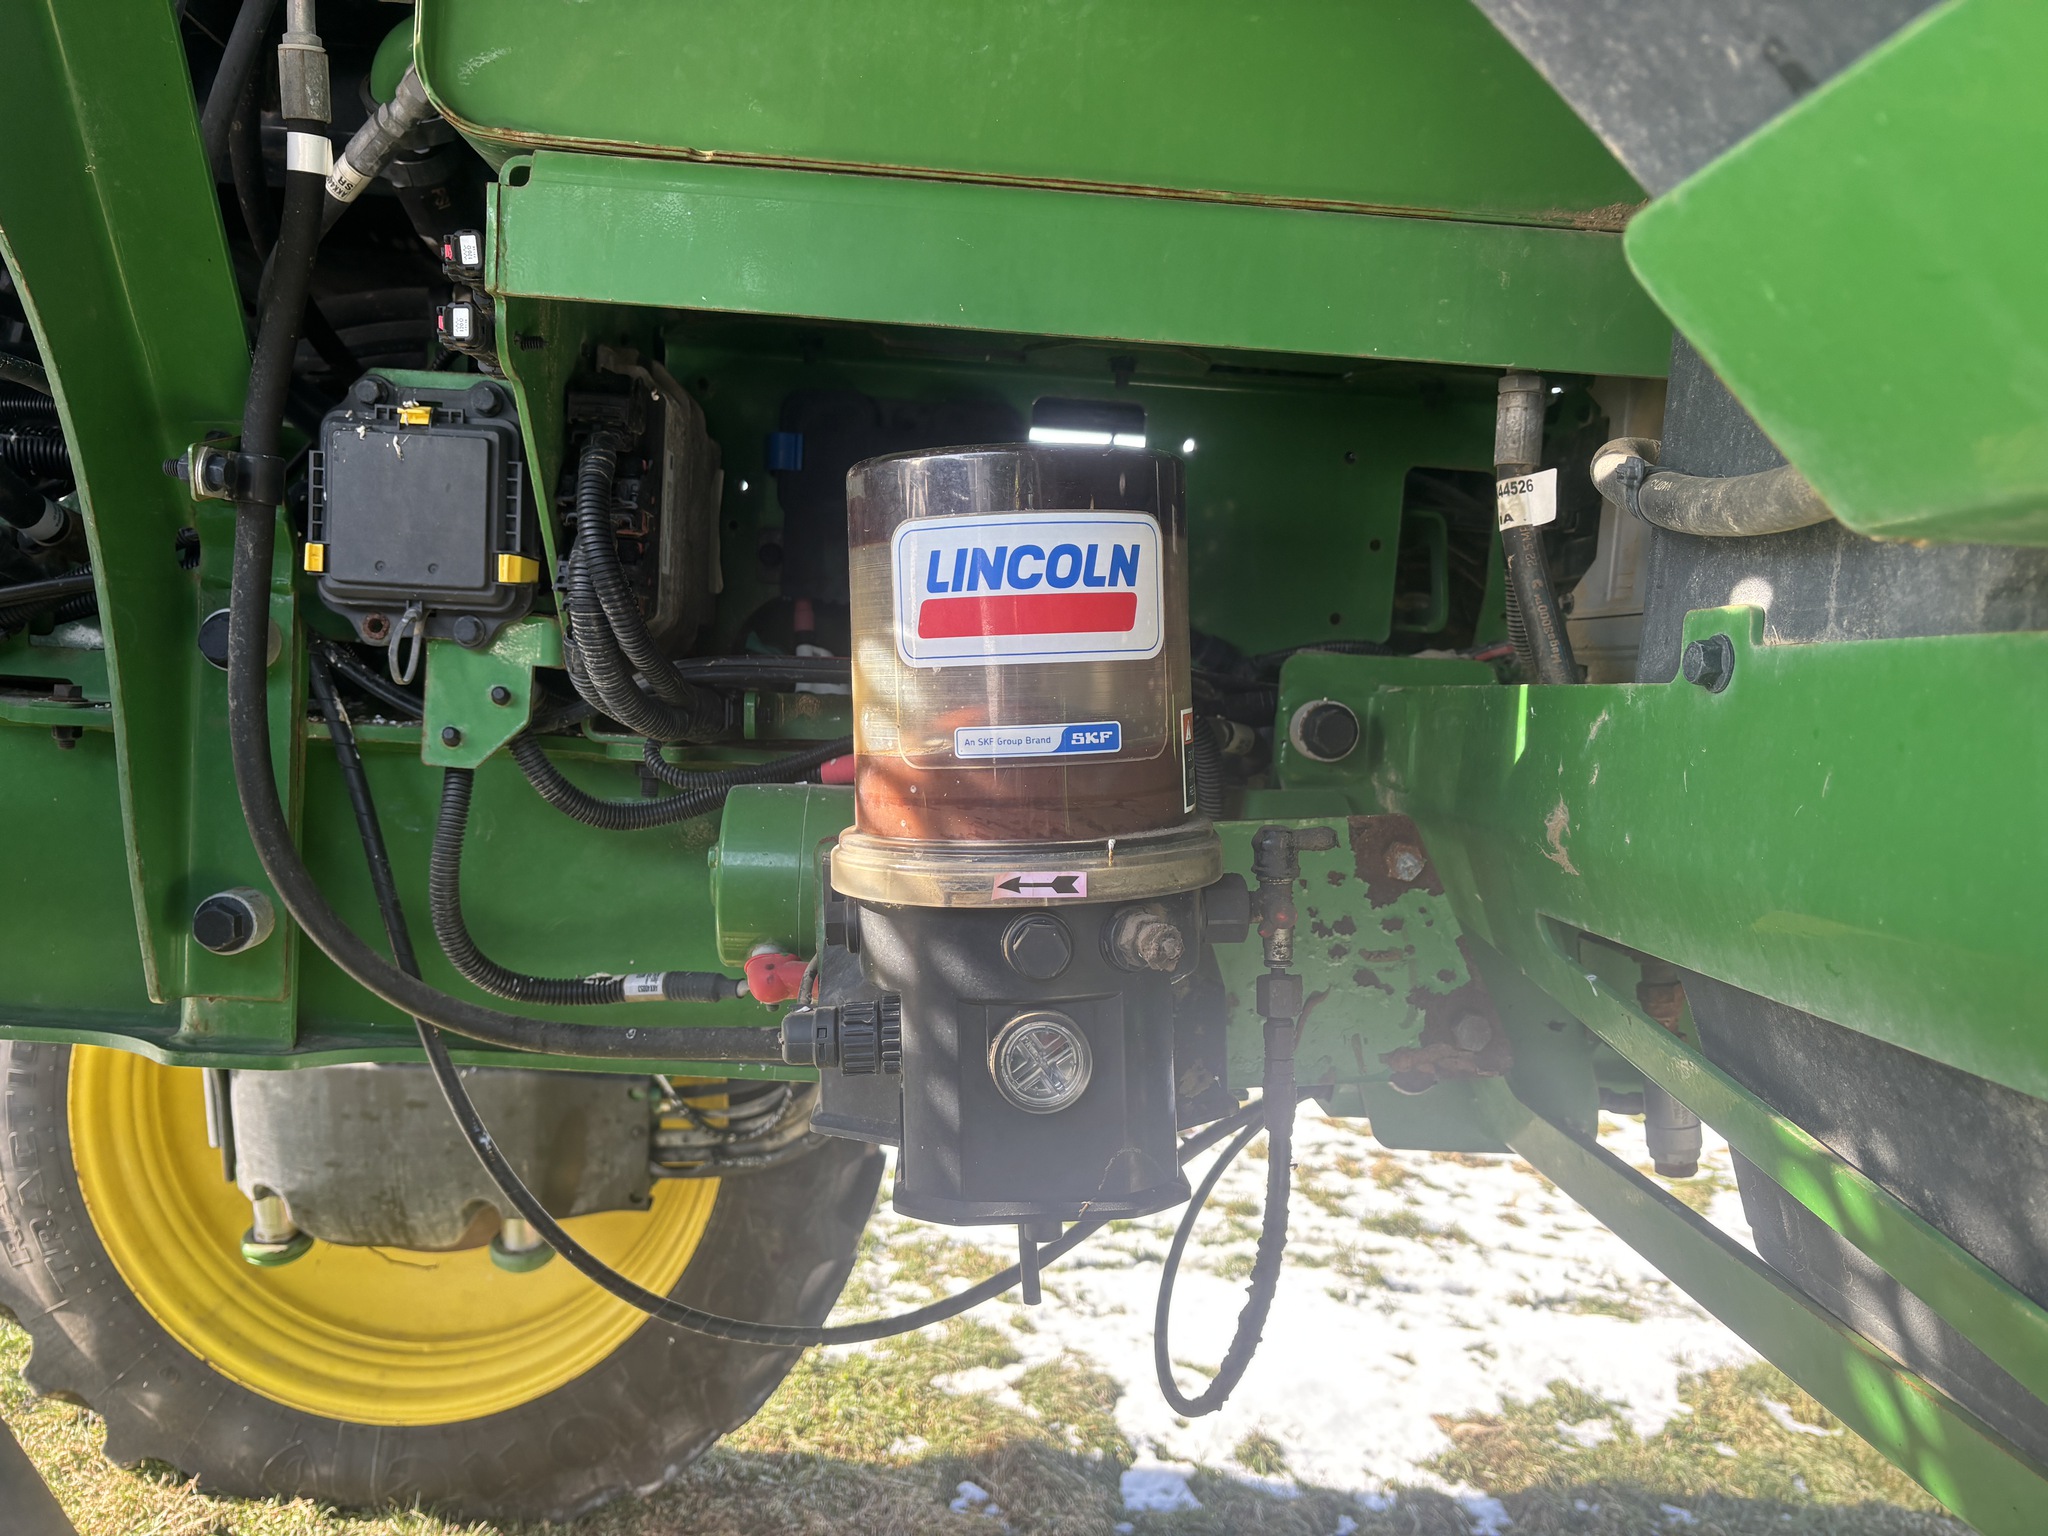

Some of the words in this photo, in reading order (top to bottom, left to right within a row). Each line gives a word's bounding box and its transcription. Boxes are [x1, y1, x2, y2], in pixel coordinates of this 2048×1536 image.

[338, 176, 354, 190] SR
[1497, 479, 1534, 498] 44526
[927, 543, 1141, 593] LINCOLN
[964, 738, 976, 746] An
[978, 737, 994, 746] SKF
[997, 737, 1023, 747] Group
[1026, 736, 1051, 745] Brand
[1071, 731, 1113, 745] SKF
